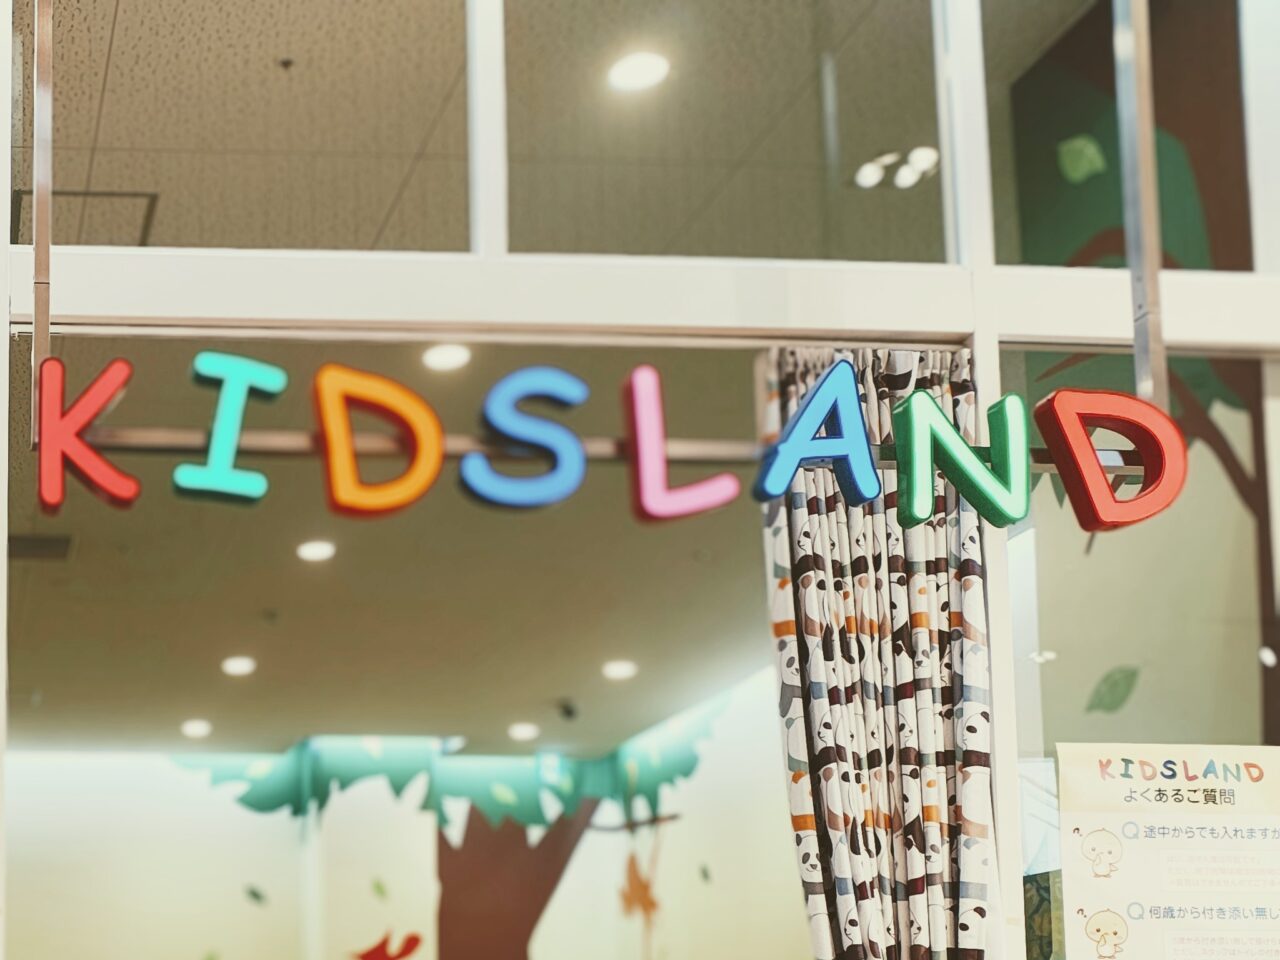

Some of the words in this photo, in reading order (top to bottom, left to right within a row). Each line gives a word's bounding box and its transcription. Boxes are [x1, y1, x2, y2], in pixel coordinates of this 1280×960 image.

[37, 350, 1189, 533] KIDSLAND
[1098, 758, 1264, 782] KIDSLAND
[1124, 788, 1235, 805] よくあるご質問
[1149, 906, 1280, 919] 何歳から付き添い無し
